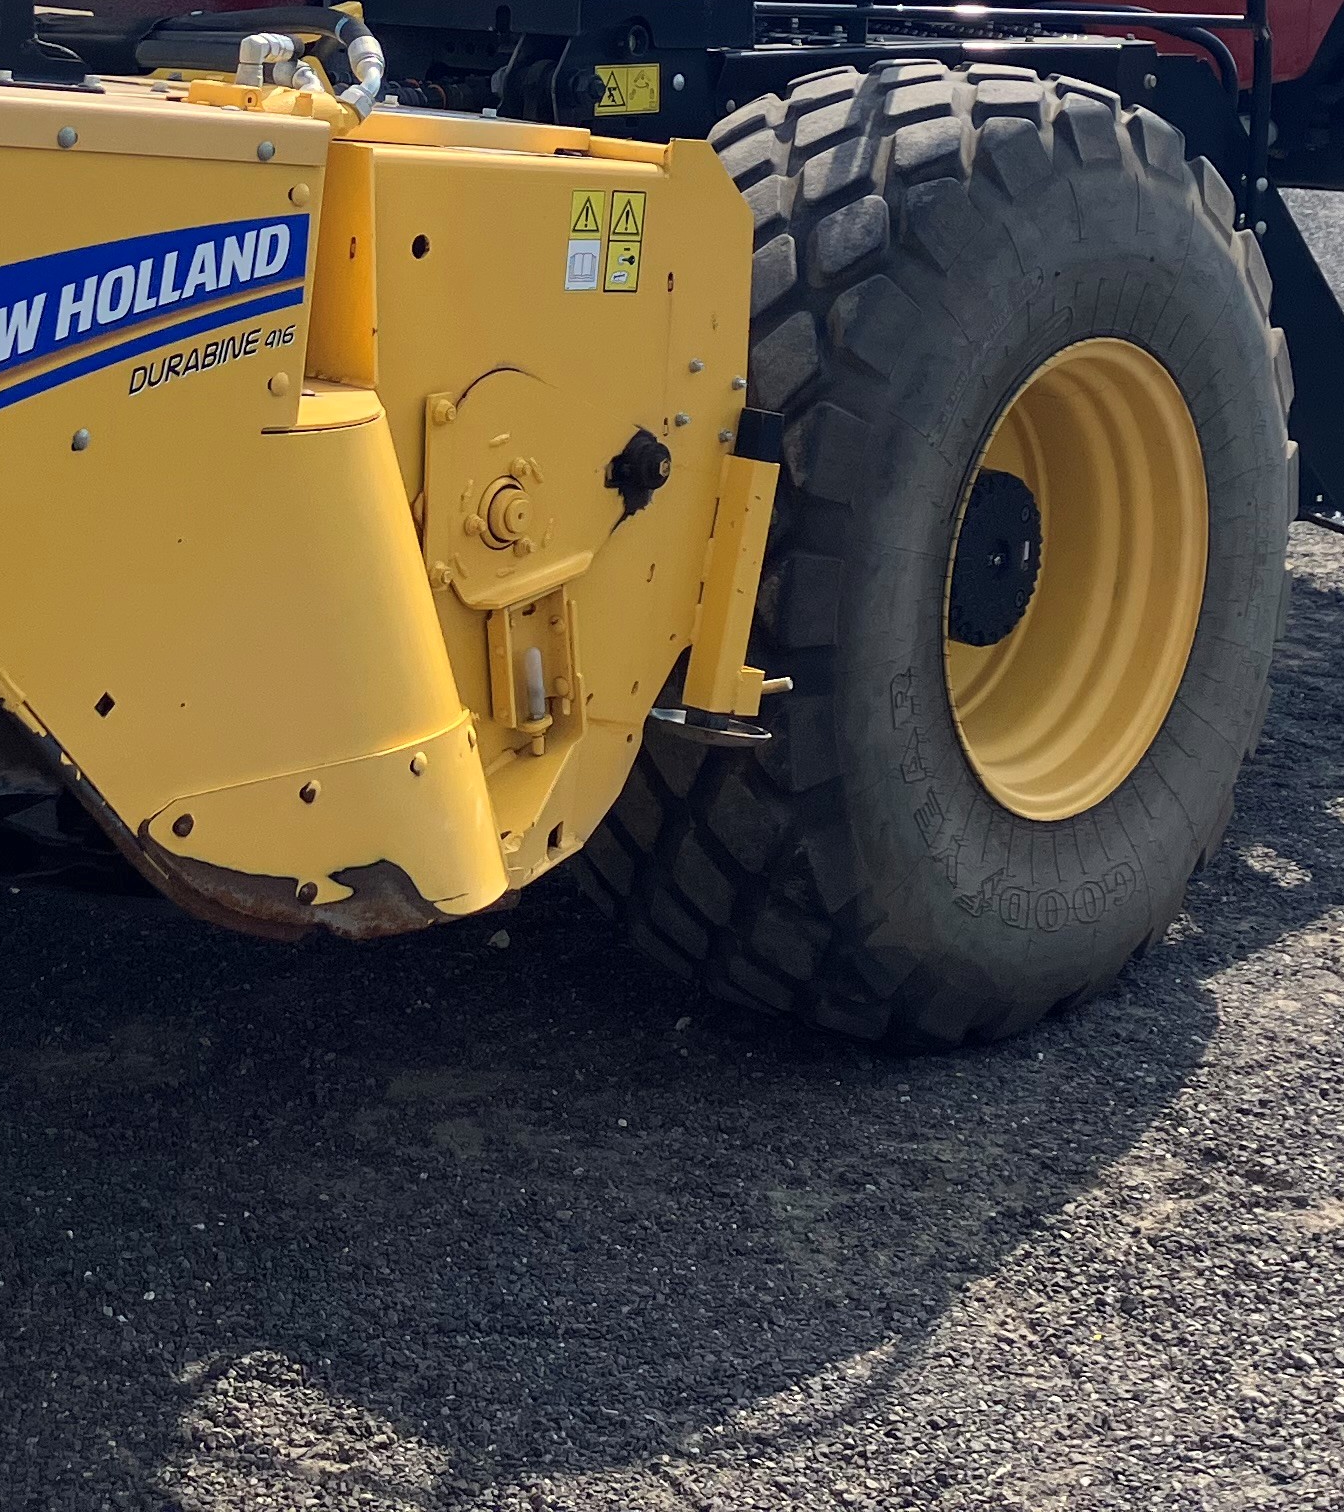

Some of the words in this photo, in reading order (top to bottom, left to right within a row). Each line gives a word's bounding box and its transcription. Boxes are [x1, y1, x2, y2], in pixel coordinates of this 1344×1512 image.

[54, 222, 291, 342] HOLLAND
[128, 327, 262, 396] DURABINE
[265, 324, 297, 355] 416
